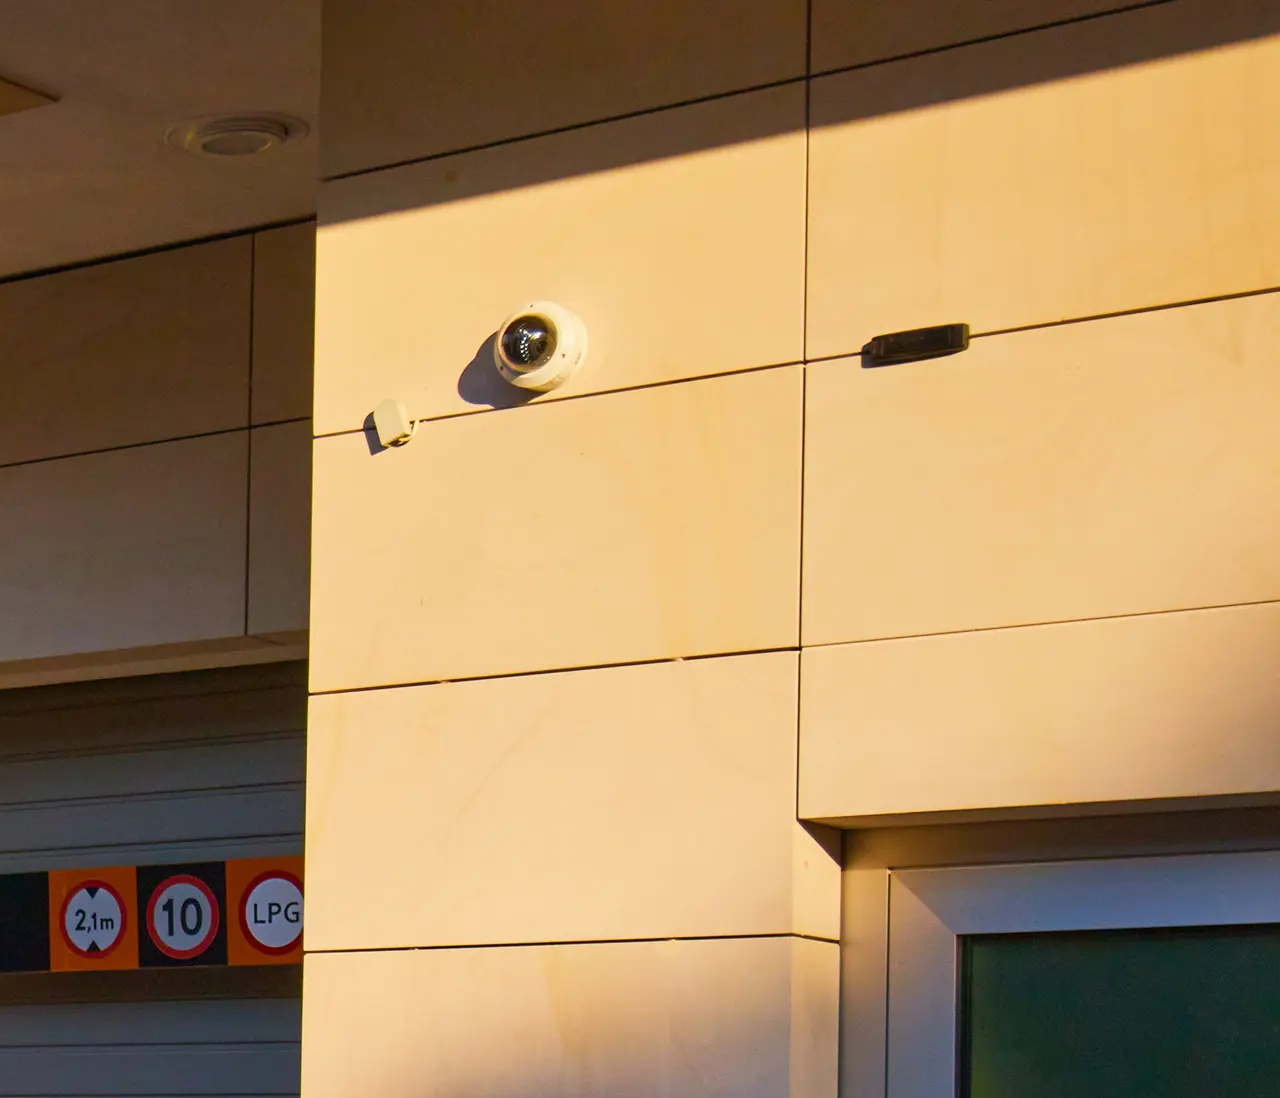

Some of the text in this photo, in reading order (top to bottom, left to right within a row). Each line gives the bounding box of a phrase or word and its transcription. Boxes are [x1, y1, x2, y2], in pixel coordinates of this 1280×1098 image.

[75, 909, 114, 934] 2,1m
[161, 897, 203, 937] 10
[253, 901, 300, 924] LPG
